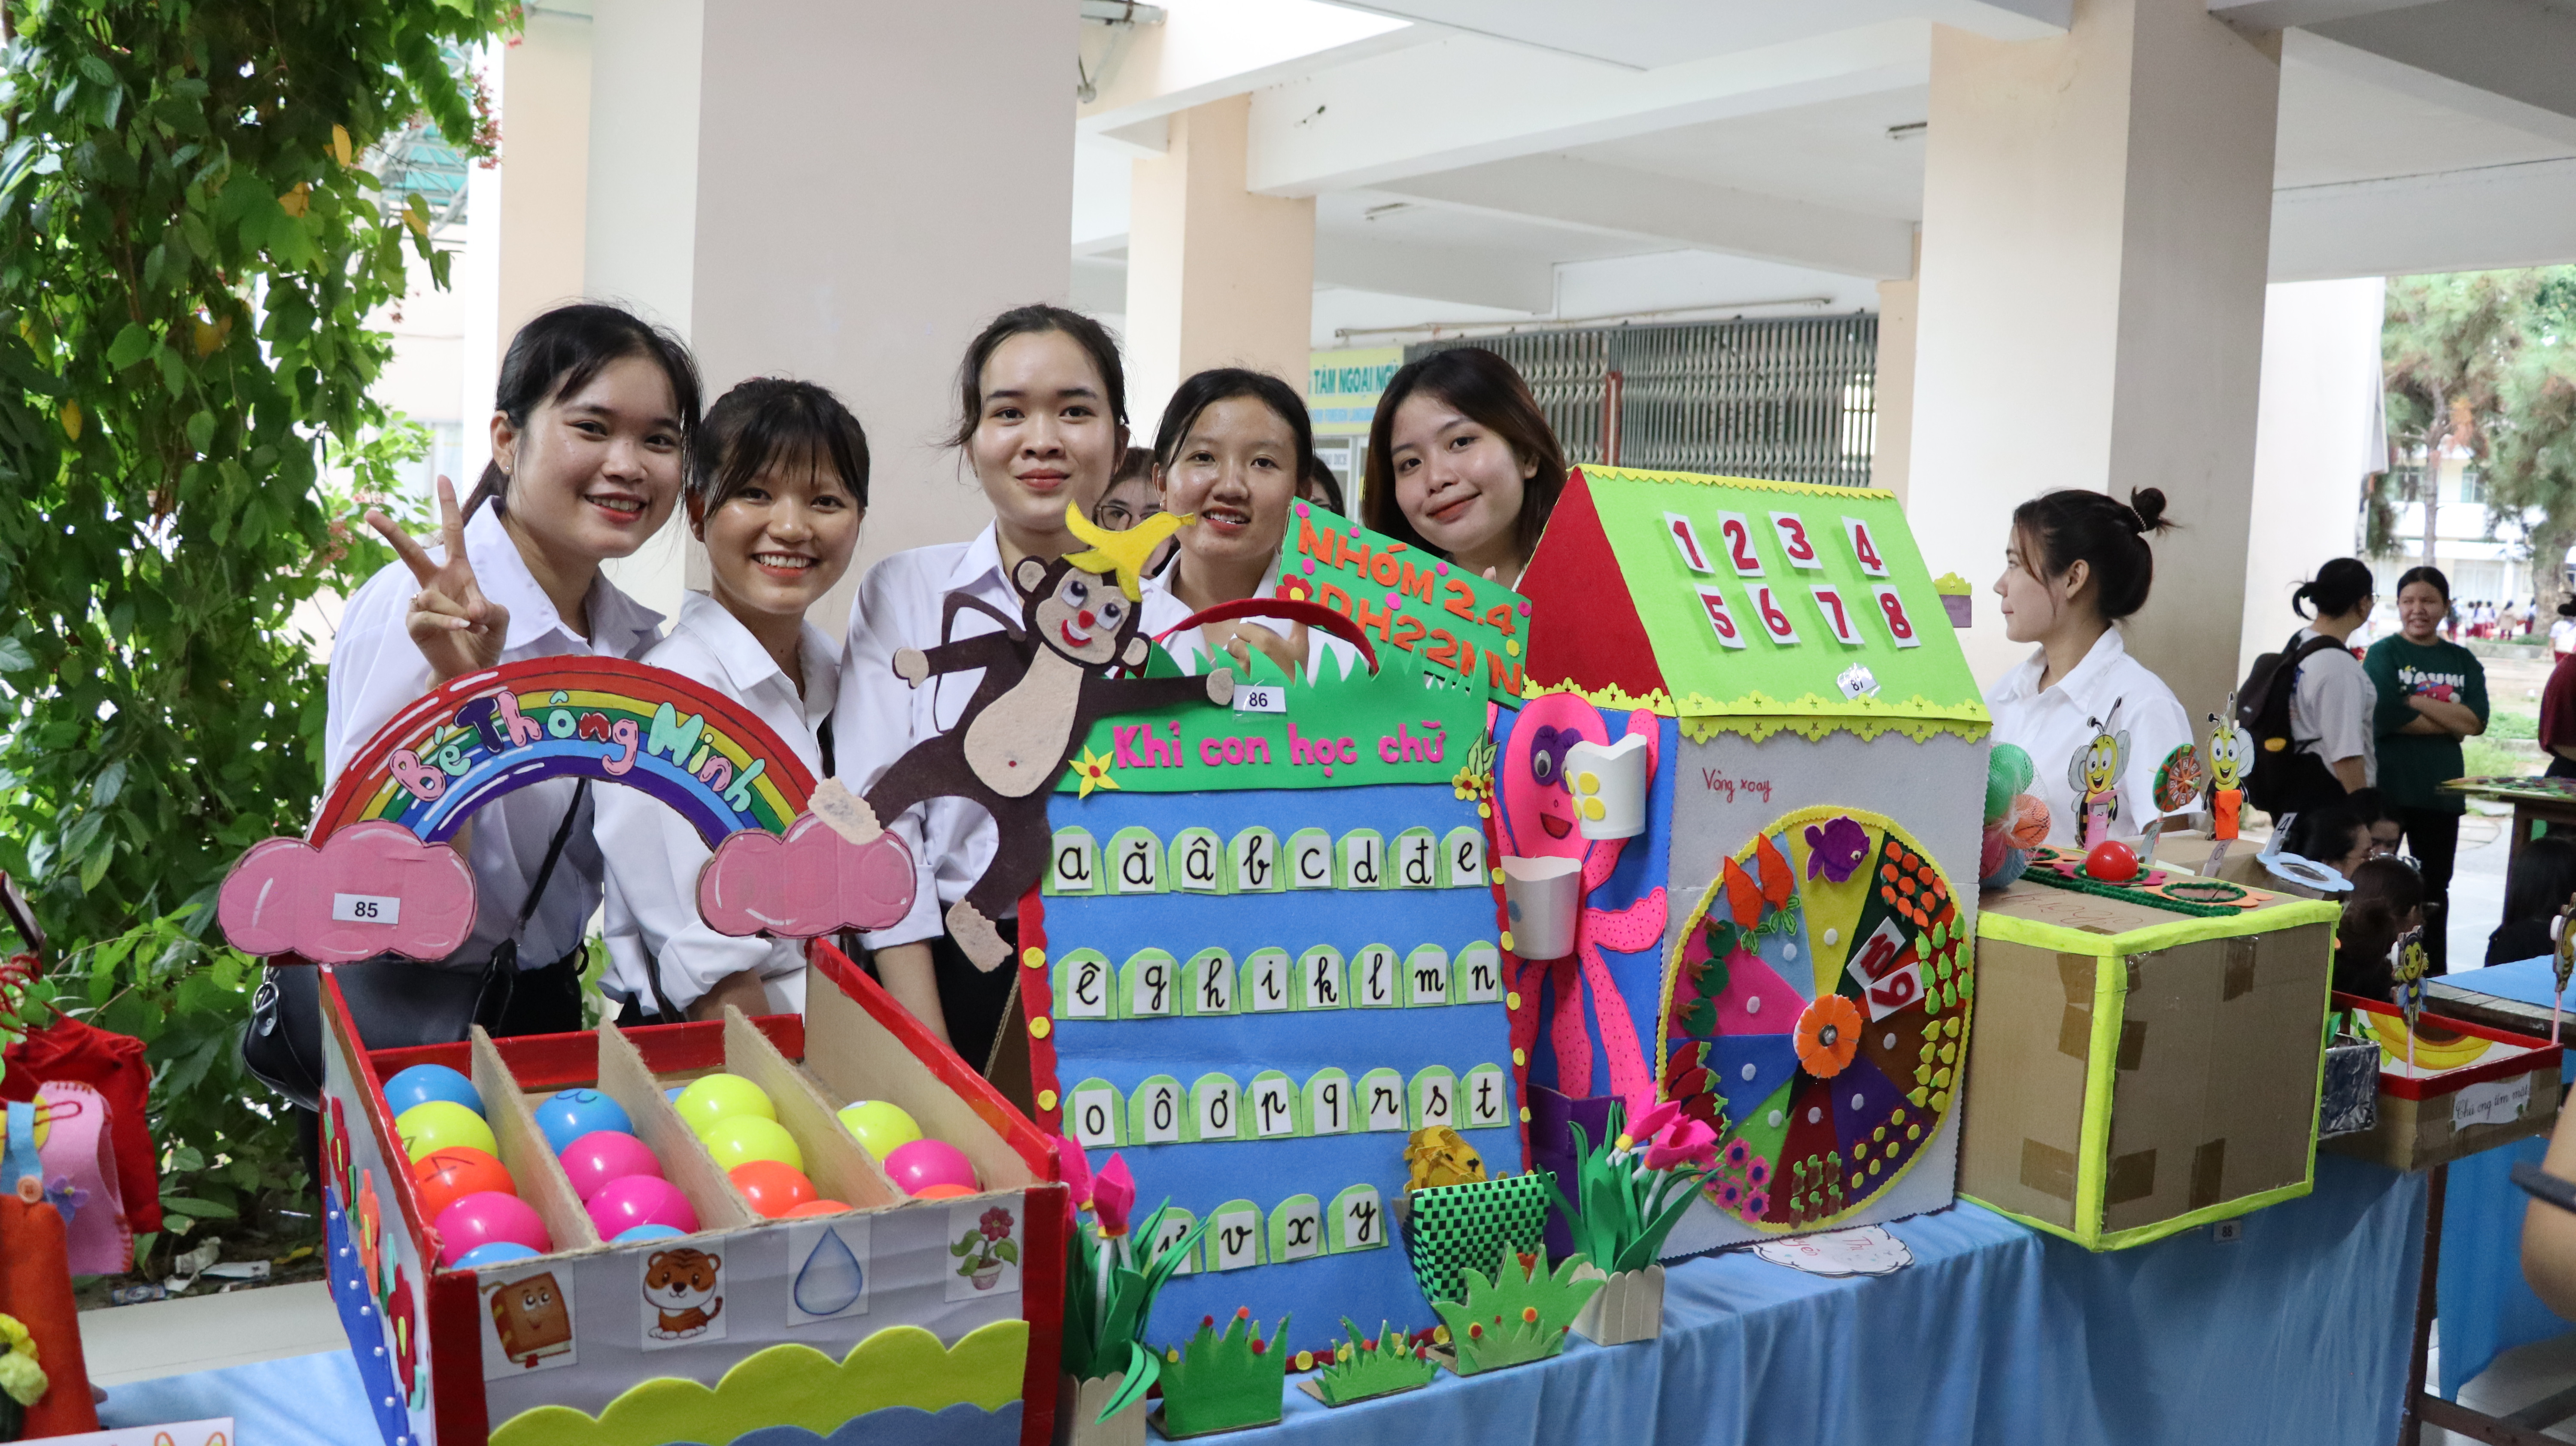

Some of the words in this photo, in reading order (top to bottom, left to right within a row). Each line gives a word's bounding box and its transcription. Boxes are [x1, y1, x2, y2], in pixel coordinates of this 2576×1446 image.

[1673, 521, 1704, 568] 1
[1723, 519, 1760, 570] 2
[1777, 518, 1814, 560] 3
[1855, 524, 1882, 570] 4
[1298, 517, 1436, 605] NHÓM
[1444, 578, 1516, 636] 2.4
[1700, 593, 1735, 638] 5
[1760, 588, 1792, 636] 6
[1815, 591, 1850, 638] 7
[1880, 593, 1912, 638] 8
[1249, 692, 1269, 708] 86
[388, 726, 473, 802] Bé
[454, 690, 640, 776] Thông
[647, 701, 769, 814] Minh
[1113, 720, 1184, 769] Khỉ
[1199, 736, 1271, 766] con
[1288, 723, 1358, 778] học
[1378, 720, 1446, 764] chữ
[1703, 767, 1735, 802] Vòng
[1740, 775, 1772, 802] xoay
[2277, 817, 2290, 834] 4
[1058, 846, 1089, 881] a
[1123, 841, 1154, 885] ă
[1185, 836, 1214, 881] â
[1243, 835, 1270, 885] b
[1300, 848, 1325, 879] c
[1355, 841, 1378, 884] d
[1406, 839, 1431, 885] đ
[1459, 841, 1476, 872] e
[354, 900, 379, 919] 85
[1860, 933, 1895, 978] 10
[1075, 962, 1101, 1006] ê
[1146, 966, 1168, 1011] g
[1204, 957, 1225, 1009] h
[1261, 961, 1280, 1000] i
[1314, 956, 1337, 1003] k
[1368, 953, 1385, 1000] l
[1415, 969, 1444, 992] m
[1471, 963, 1495, 990] n
[1086, 1104, 1105, 1135] o
[1154, 1088, 1172, 1130] ô
[1210, 1089, 1228, 1129] ơ
[1262, 1090, 1286, 1131] p
[1323, 1083, 1338, 1127] q
[1371, 1087, 1398, 1115] r
[1425, 1086, 1447, 1117] s
[1475, 1078, 1496, 1118] t
[1221, 1224, 1253, 1255] v
[1288, 1216, 1315, 1247] x
[1349, 1199, 1376, 1242] y
[2222, 1225, 2232, 1238] 88
